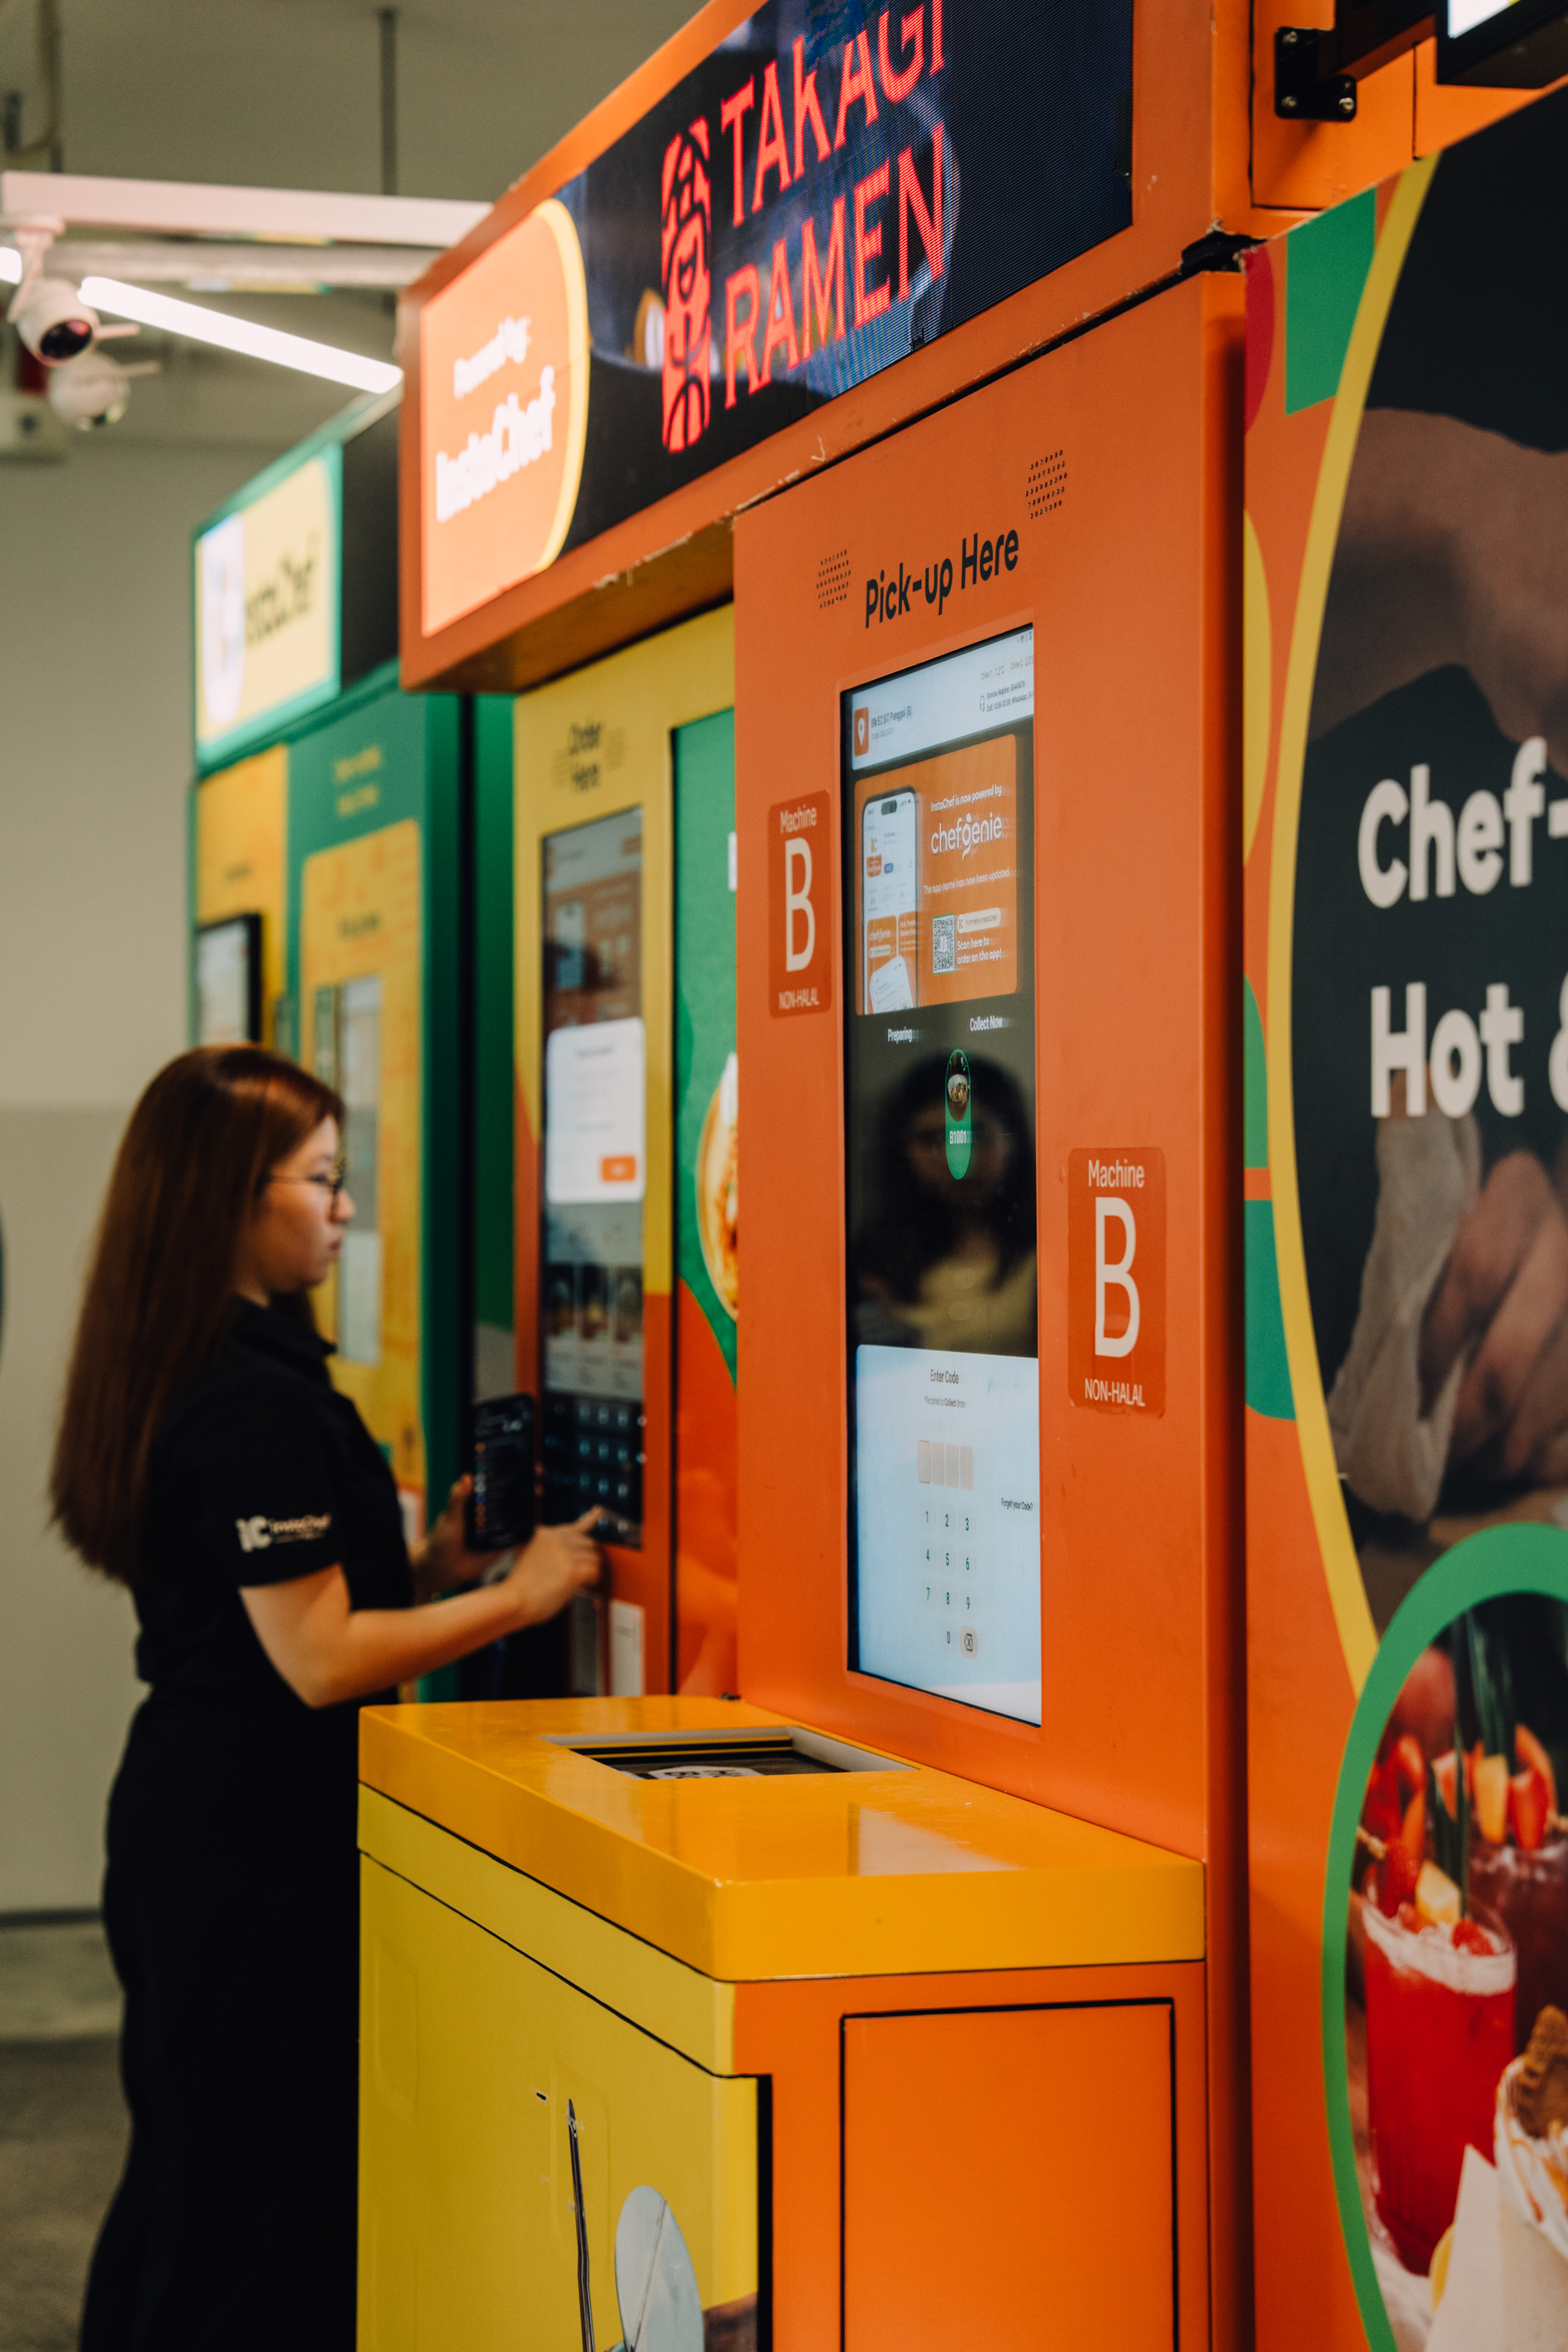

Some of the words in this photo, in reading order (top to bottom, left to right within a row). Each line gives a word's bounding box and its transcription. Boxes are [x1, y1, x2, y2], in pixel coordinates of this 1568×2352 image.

[724, 119, 945, 410] RAMEN
[865, 557, 953, 629] Pick-up
[961, 528, 1019, 590] Here
[987, 691, 997, 699] Service
[998, 686, 1010, 696] Helpline:
[890, 706, 906, 722] Punggol
[931, 795, 955, 812] InstaChef
[955, 795, 960, 805] is
[960, 794, 971, 803] now
[972, 785, 993, 804] powered
[994, 783, 1002, 797] by
[780, 804, 817, 835] Machine
[931, 812, 1002, 861] chefgenie
[924, 885, 932, 894] The
[933, 885, 941, 894] app
[942, 882, 955, 891] name
[956, 878, 965, 887] has
[965, 877, 976, 886] now
[976, 874, 988, 883] been
[989, 867, 1010, 882] updated.
[785, 837, 816, 973] B
[966, 916, 981, 926] Formerly
[957, 940, 970, 951] Scan
[971, 938, 982, 948] here
[983, 936, 990, 946] to
[957, 953, 971, 965] order
[972, 953, 978, 963] on
[979, 950, 988, 961] the
[989, 947, 1002, 961] app!
[778, 987, 820, 1011] NON-HALAL
[970, 1015, 989, 1032] Collect
[990, 1015, 1003, 1029] Now
[887, 1026, 913, 1044] Preparing
[1370, 980, 1525, 1119] Hot
[949, 1130, 967, 1145] B1001
[1088, 1158, 1145, 1188] Machine
[1094, 1196, 1141, 1358] B
[930, 1369, 944, 1383] Enter
[945, 1370, 959, 1384] Code
[940, 1398, 944, 1406] to
[944, 1398, 956, 1407] Collect
[956, 1399, 966, 1409] Order
[1084, 1378, 1146, 1407] NON-HALAL
[1001, 1498, 1012, 1510] Forget
[1012, 1502, 1021, 1511] your
[1021, 1502, 1033, 1512] Code?
[926, 1510, 929, 1523] 1
[945, 1514, 949, 1527] 2
[965, 1518, 969, 1531] 3
[926, 1549, 930, 1562] 4
[946, 1553, 950, 1566] 5
[966, 1557, 970, 1571] 6
[926, 1587, 930, 1601] 7
[946, 1592, 950, 1605] 8
[967, 1596, 970, 1609] 9
[946, 1631, 950, 1644] 0
